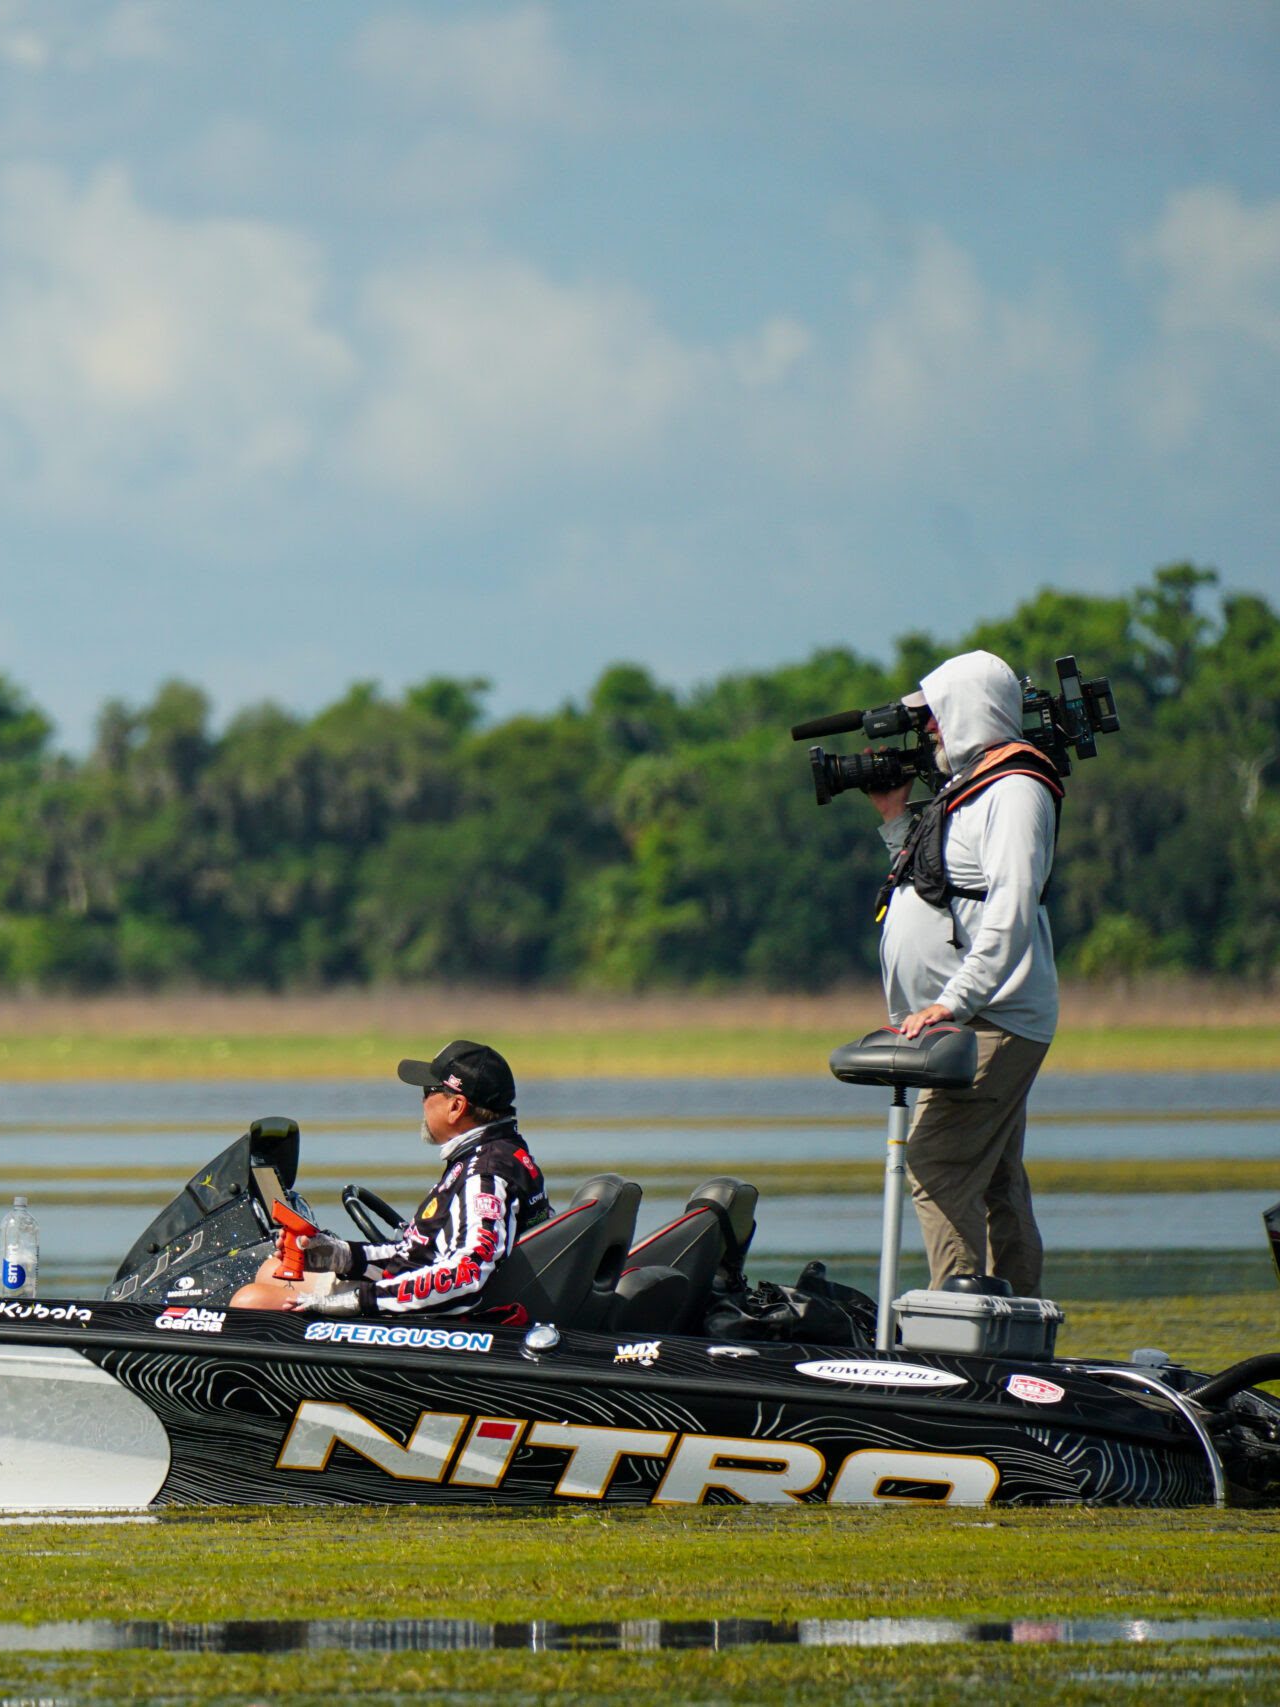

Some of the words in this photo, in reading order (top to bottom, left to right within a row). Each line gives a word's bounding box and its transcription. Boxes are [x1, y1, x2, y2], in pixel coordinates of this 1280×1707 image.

[396, 1256, 480, 1303] LUCAS
[167, 1290, 189, 1298] MOSSY
[182, 1307, 227, 1322] Abu
[155, 1315, 223, 1332] Garcia
[331, 1325, 493, 1351] FERGUSON
[617, 1340, 663, 1357] WIX
[817, 1365, 949, 1382] POWER-POLE
